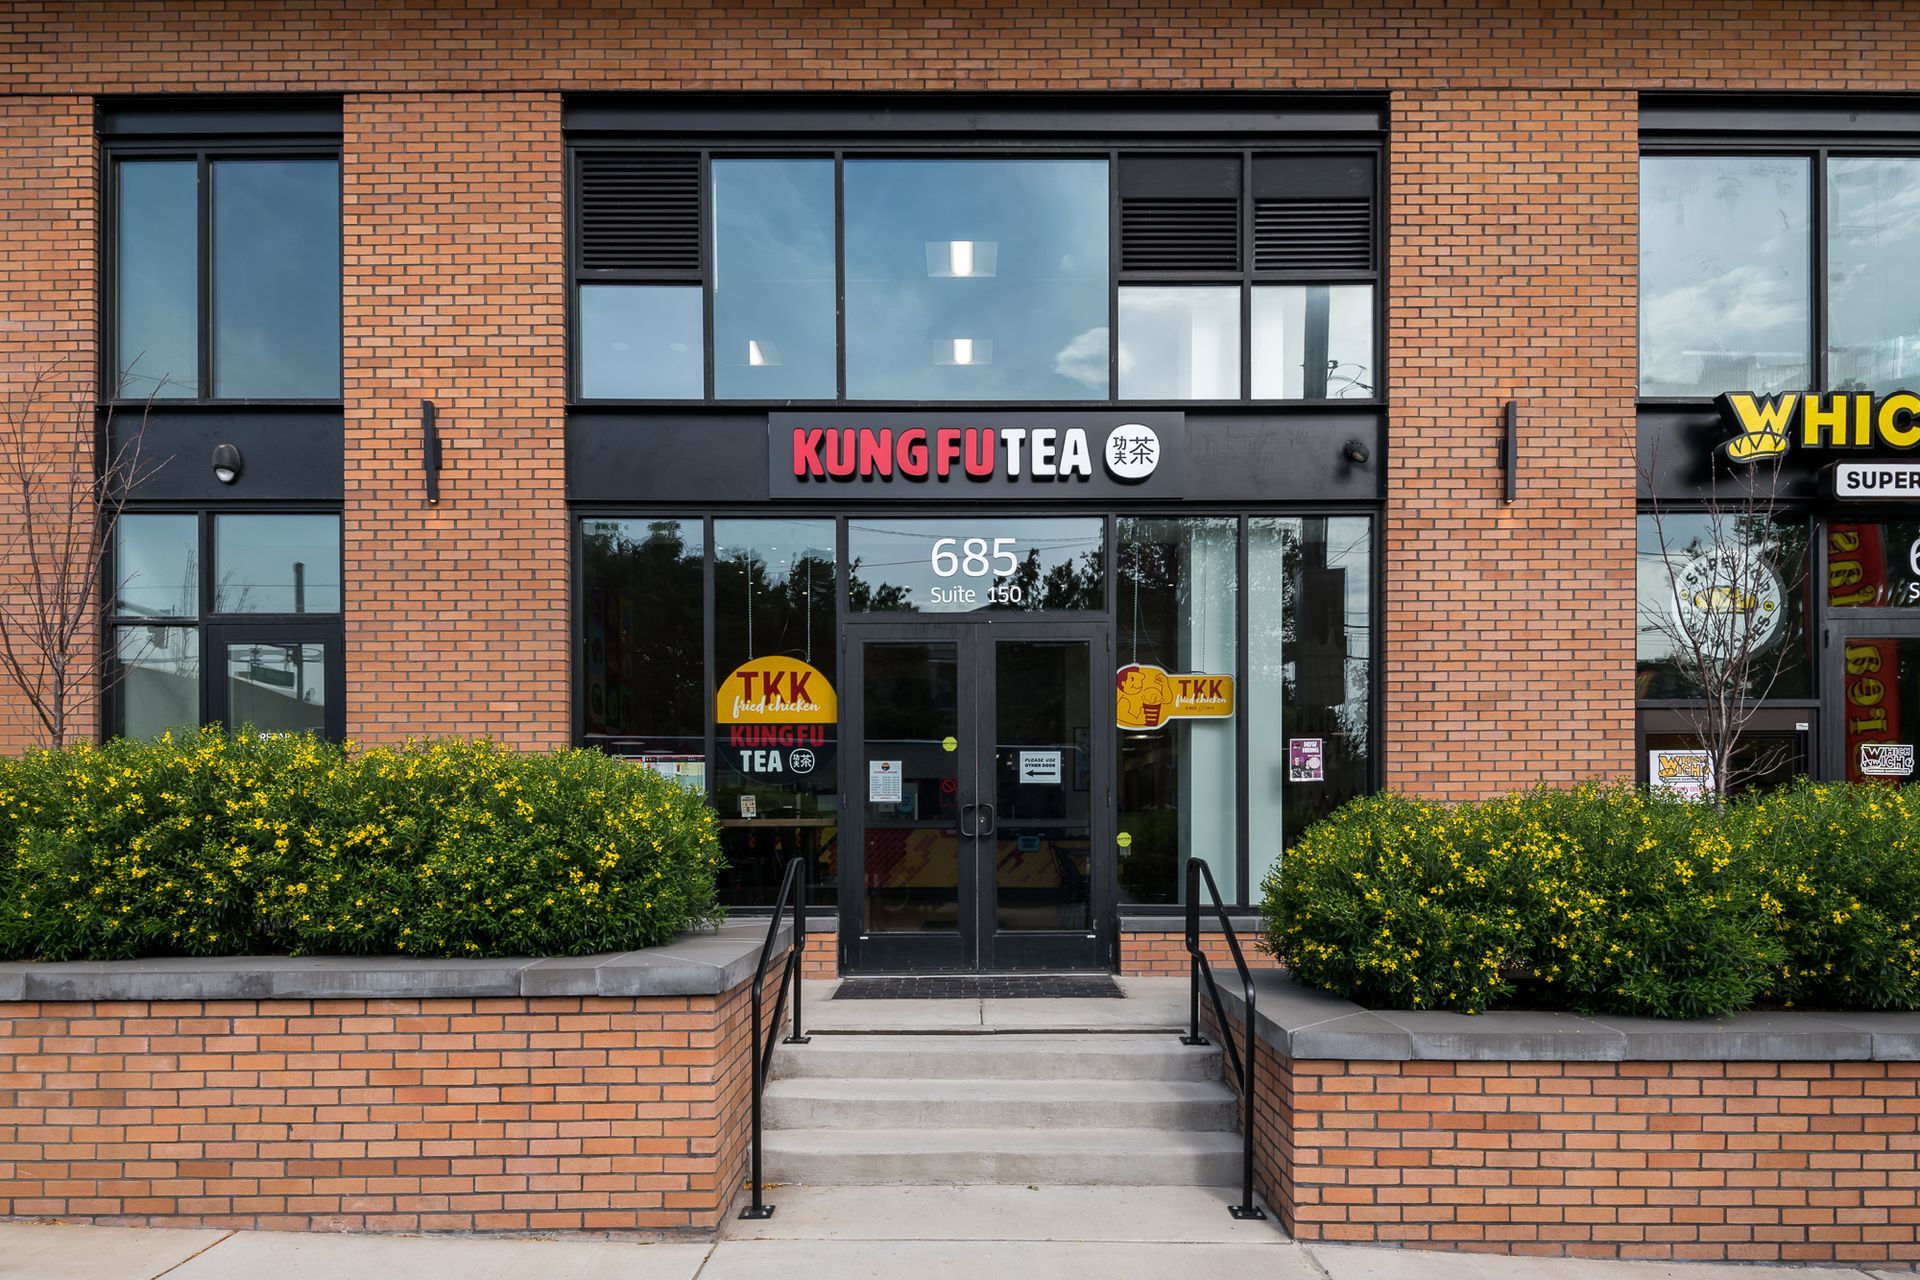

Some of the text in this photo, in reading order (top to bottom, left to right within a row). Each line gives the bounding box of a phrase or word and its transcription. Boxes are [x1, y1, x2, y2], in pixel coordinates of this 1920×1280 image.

[1727, 393, 1920, 460] WHIC
[1000, 428, 1093, 477] TEA
[931, 537, 1018, 578] 685
[931, 585, 1022, 604] Suite 150
[736, 671, 813, 705] TKK
[1175, 692, 1229, 707] fried chicken
[1178, 679, 1223, 699] TKK
[732, 694, 821, 719] fried chicken
[739, 749, 784, 773] TEA
